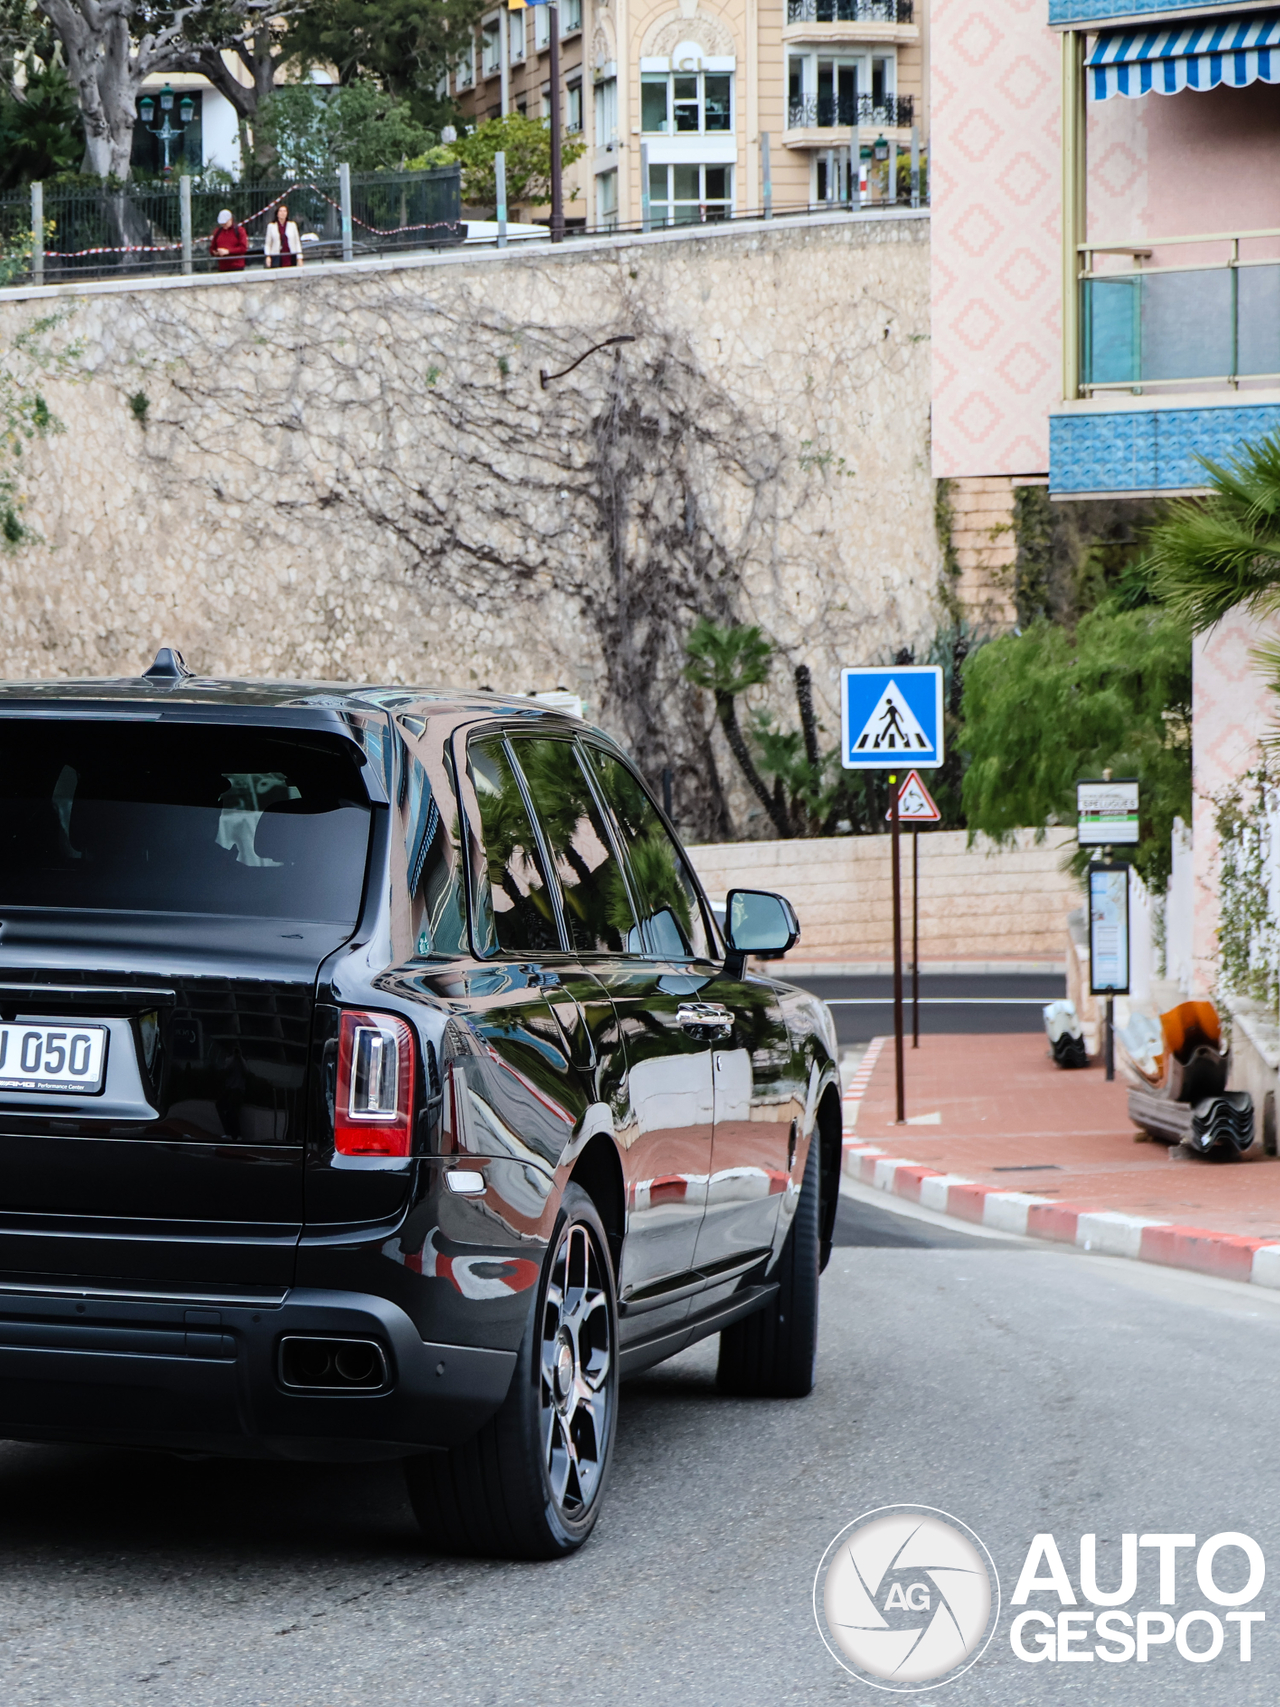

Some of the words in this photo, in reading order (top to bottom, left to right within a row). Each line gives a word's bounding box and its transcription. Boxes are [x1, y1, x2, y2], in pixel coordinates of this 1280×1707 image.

[668, 57, 709, 71] LCL
[20, 1031, 91, 1075] 050
[5, 1080, 36, 1088] AMG
